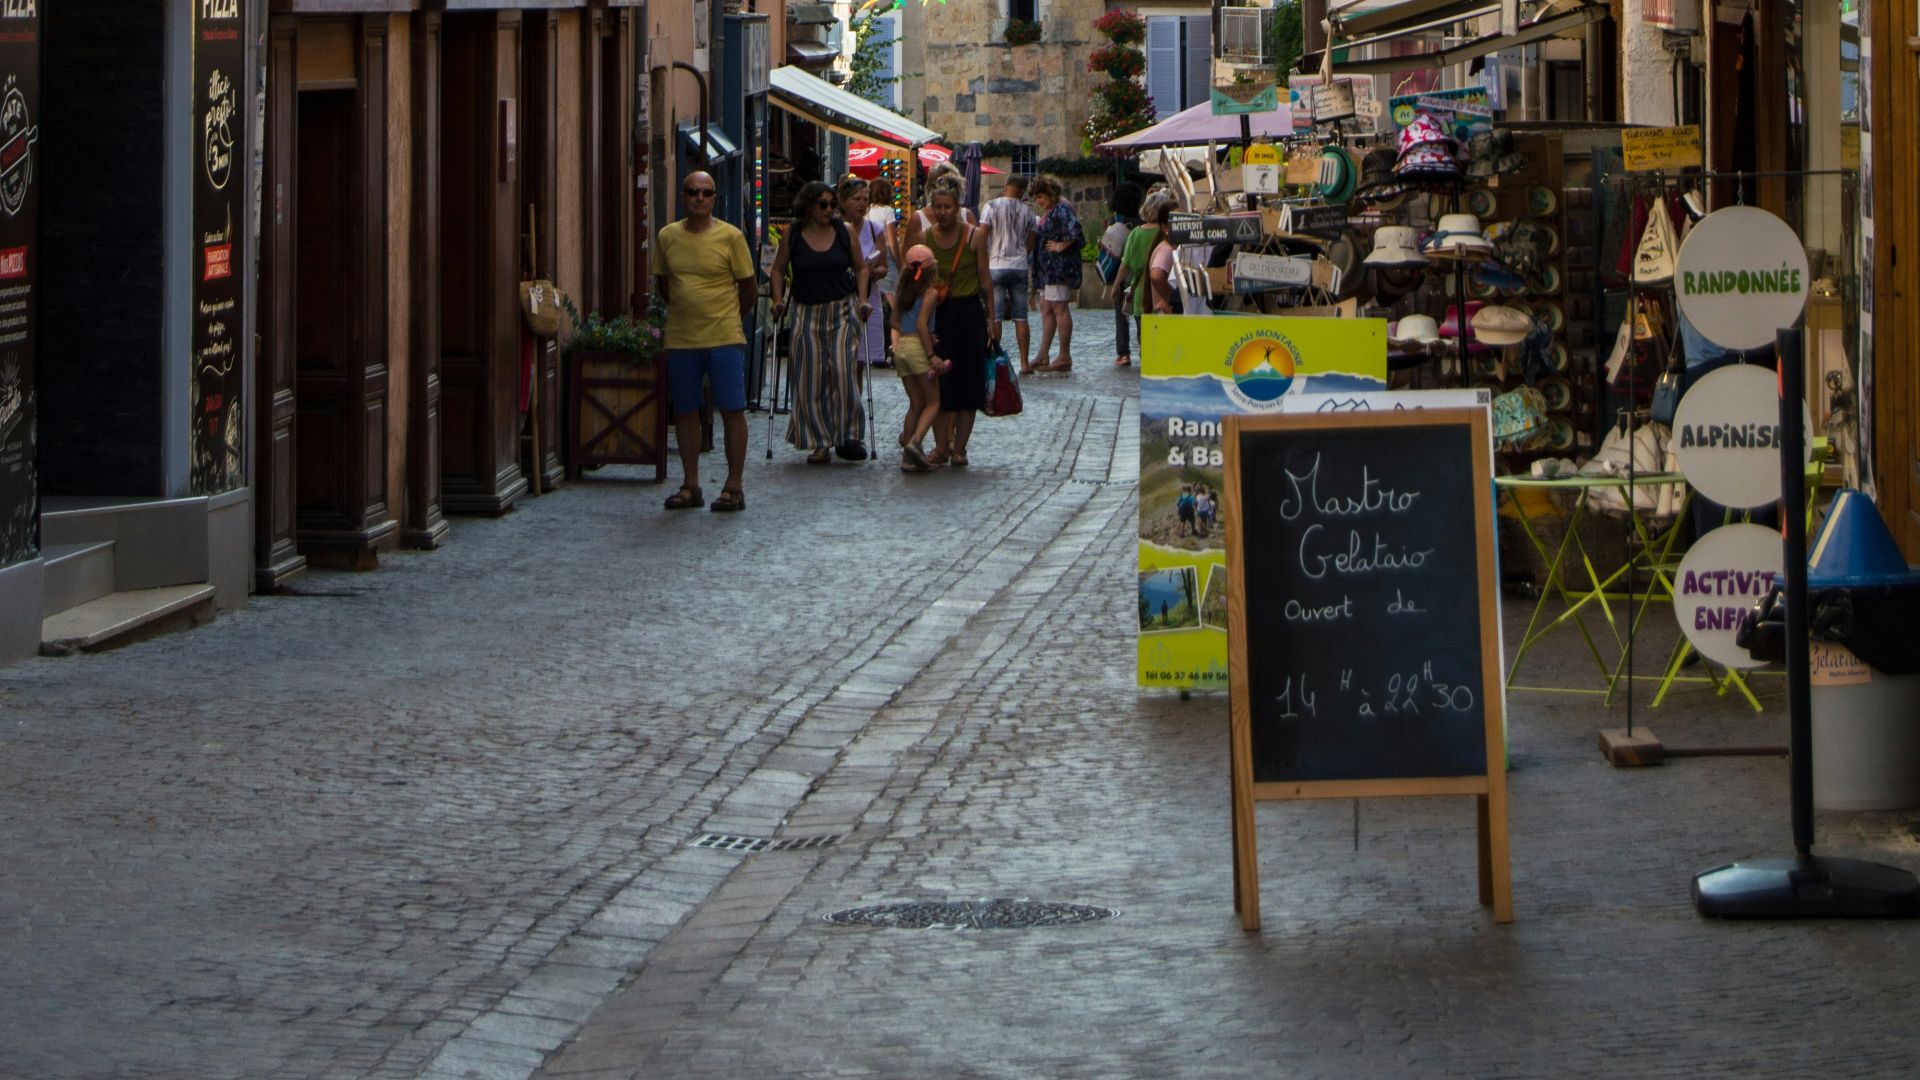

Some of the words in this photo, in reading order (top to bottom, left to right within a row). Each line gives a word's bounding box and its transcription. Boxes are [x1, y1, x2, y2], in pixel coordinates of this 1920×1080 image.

[2, 0, 37, 18] IZZA
[202, 0, 238, 18] PIZZA
[1171, 221, 1203, 231] INTERDIT
[1190, 230, 1205, 240] AUX
[1207, 229, 1228, 239] CONS
[1683, 261, 1801, 296] RANDONNÉE
[1224, 331, 1254, 368] BUREAU
[1255, 328, 1304, 367] MONTAGNE
[1167, 446, 1185, 466] &
[1193, 446, 1223, 466] Ba
[1279, 451, 1421, 521] Mastro
[1299, 524, 1435, 580] Gelataio
[1284, 595, 1354, 621] Ouvert
[1386, 588, 1428, 613] de
[1145, 670, 1158, 680] Tél
[1160, 671, 1172, 680] 06
[1174, 671, 1185, 680] 37
[1188, 671, 1200, 680] 46
